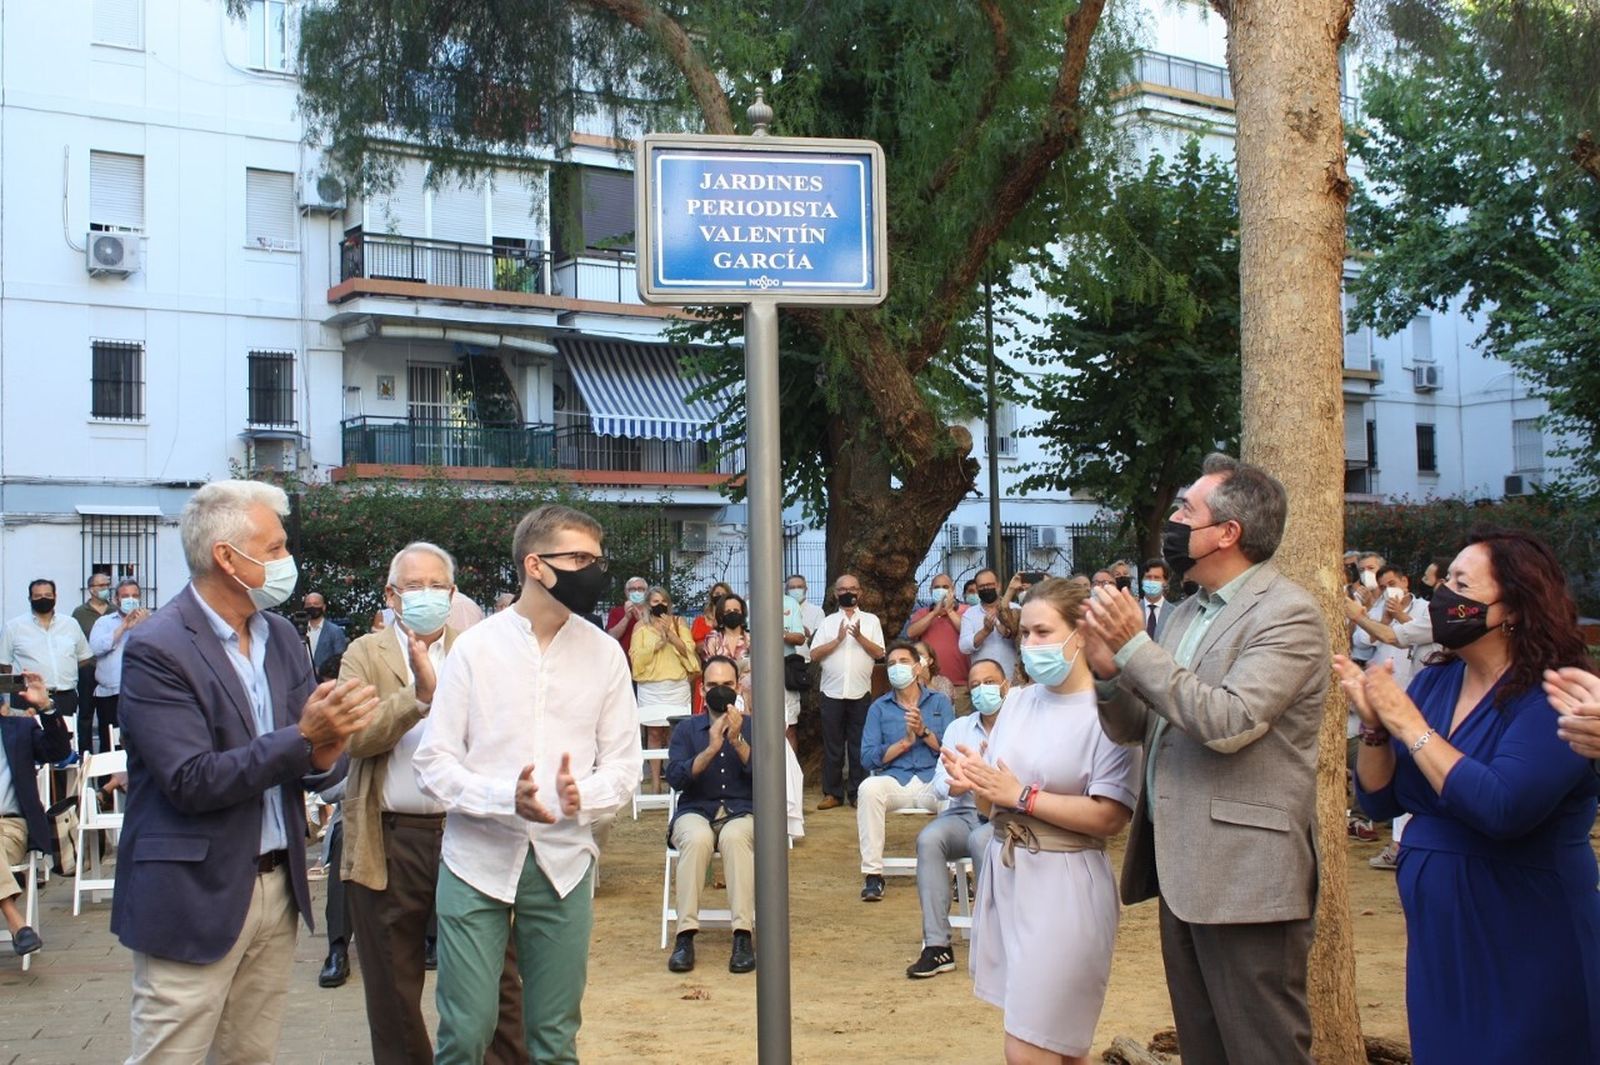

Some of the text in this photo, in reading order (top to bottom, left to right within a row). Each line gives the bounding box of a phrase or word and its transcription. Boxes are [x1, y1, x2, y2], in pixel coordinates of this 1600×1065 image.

[699, 172, 823, 192] JARDINES
[686, 199, 838, 219] PERIODISTA
[699, 223, 826, 244] VALENTÍN
[713, 248, 814, 270] GARCÍA
